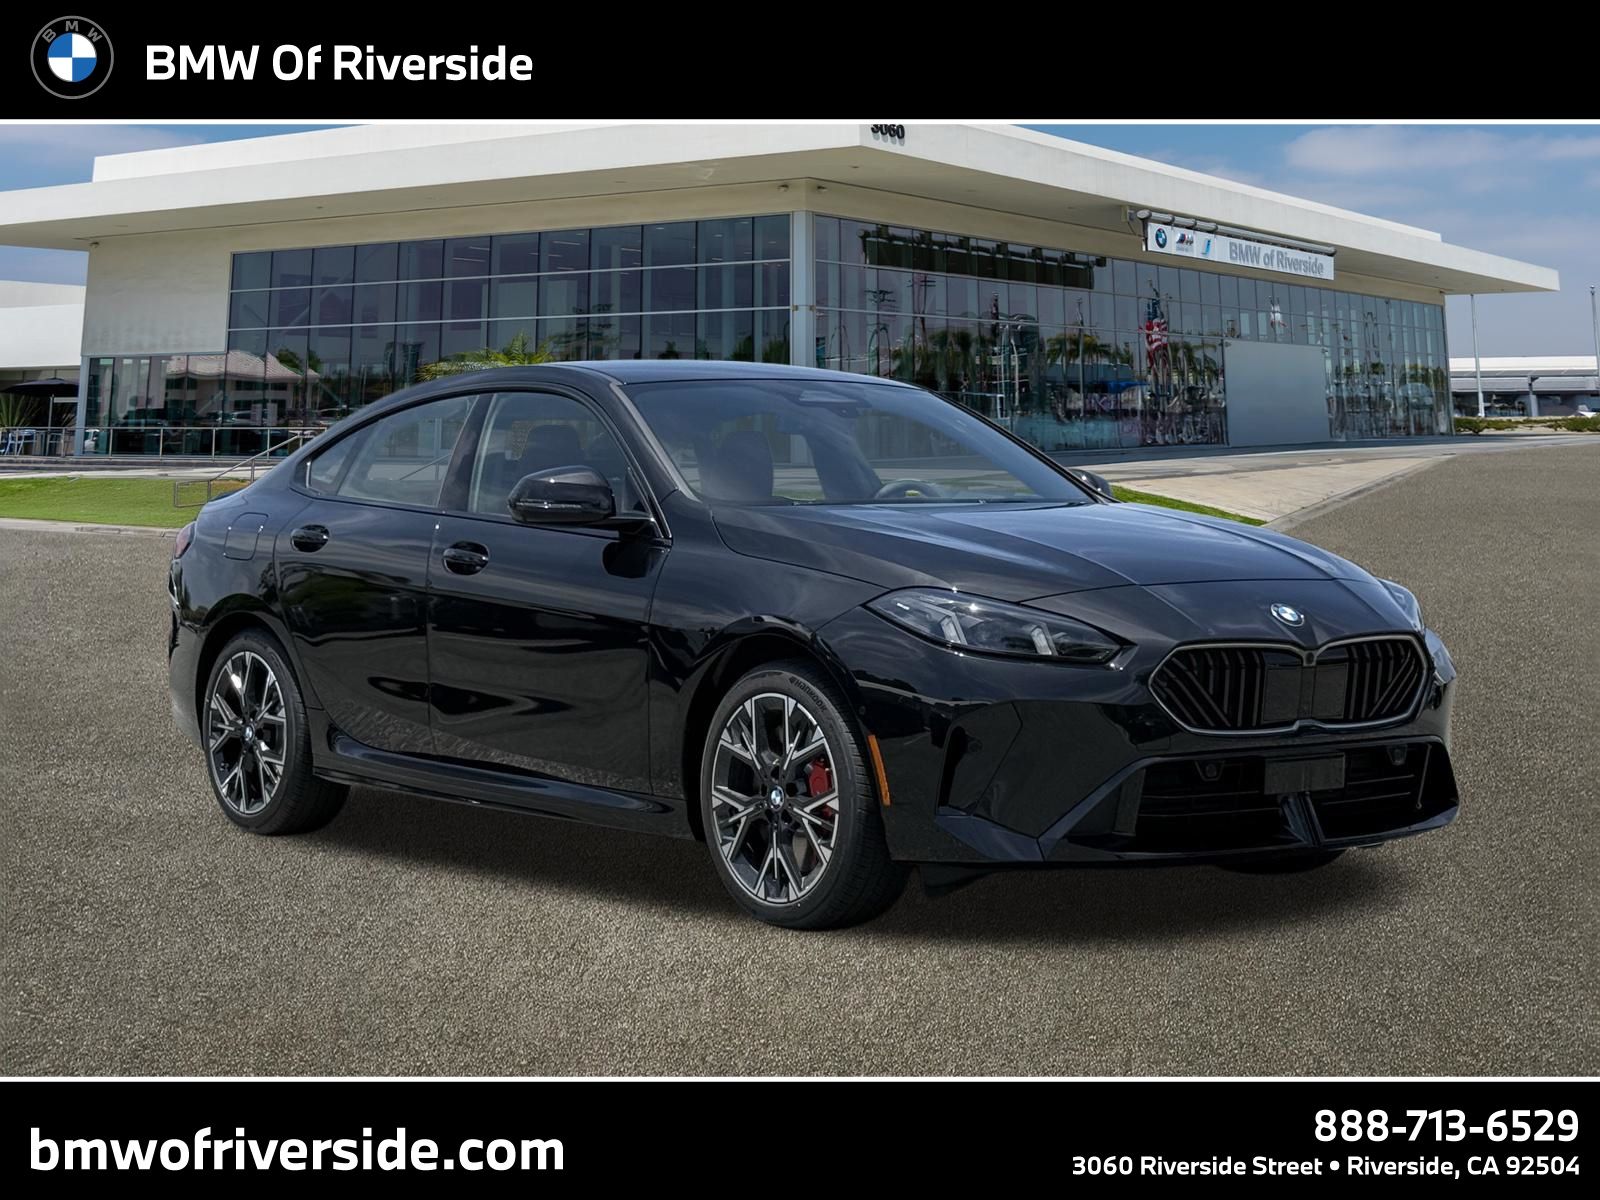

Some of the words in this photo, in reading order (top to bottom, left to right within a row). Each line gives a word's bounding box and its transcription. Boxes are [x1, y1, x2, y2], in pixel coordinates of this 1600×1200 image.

[871, 123, 905, 139] 3060
[1229, 241, 1261, 265] BMW
[1263, 249, 1276, 268] of
[1276, 250, 1324, 275] Riverside
